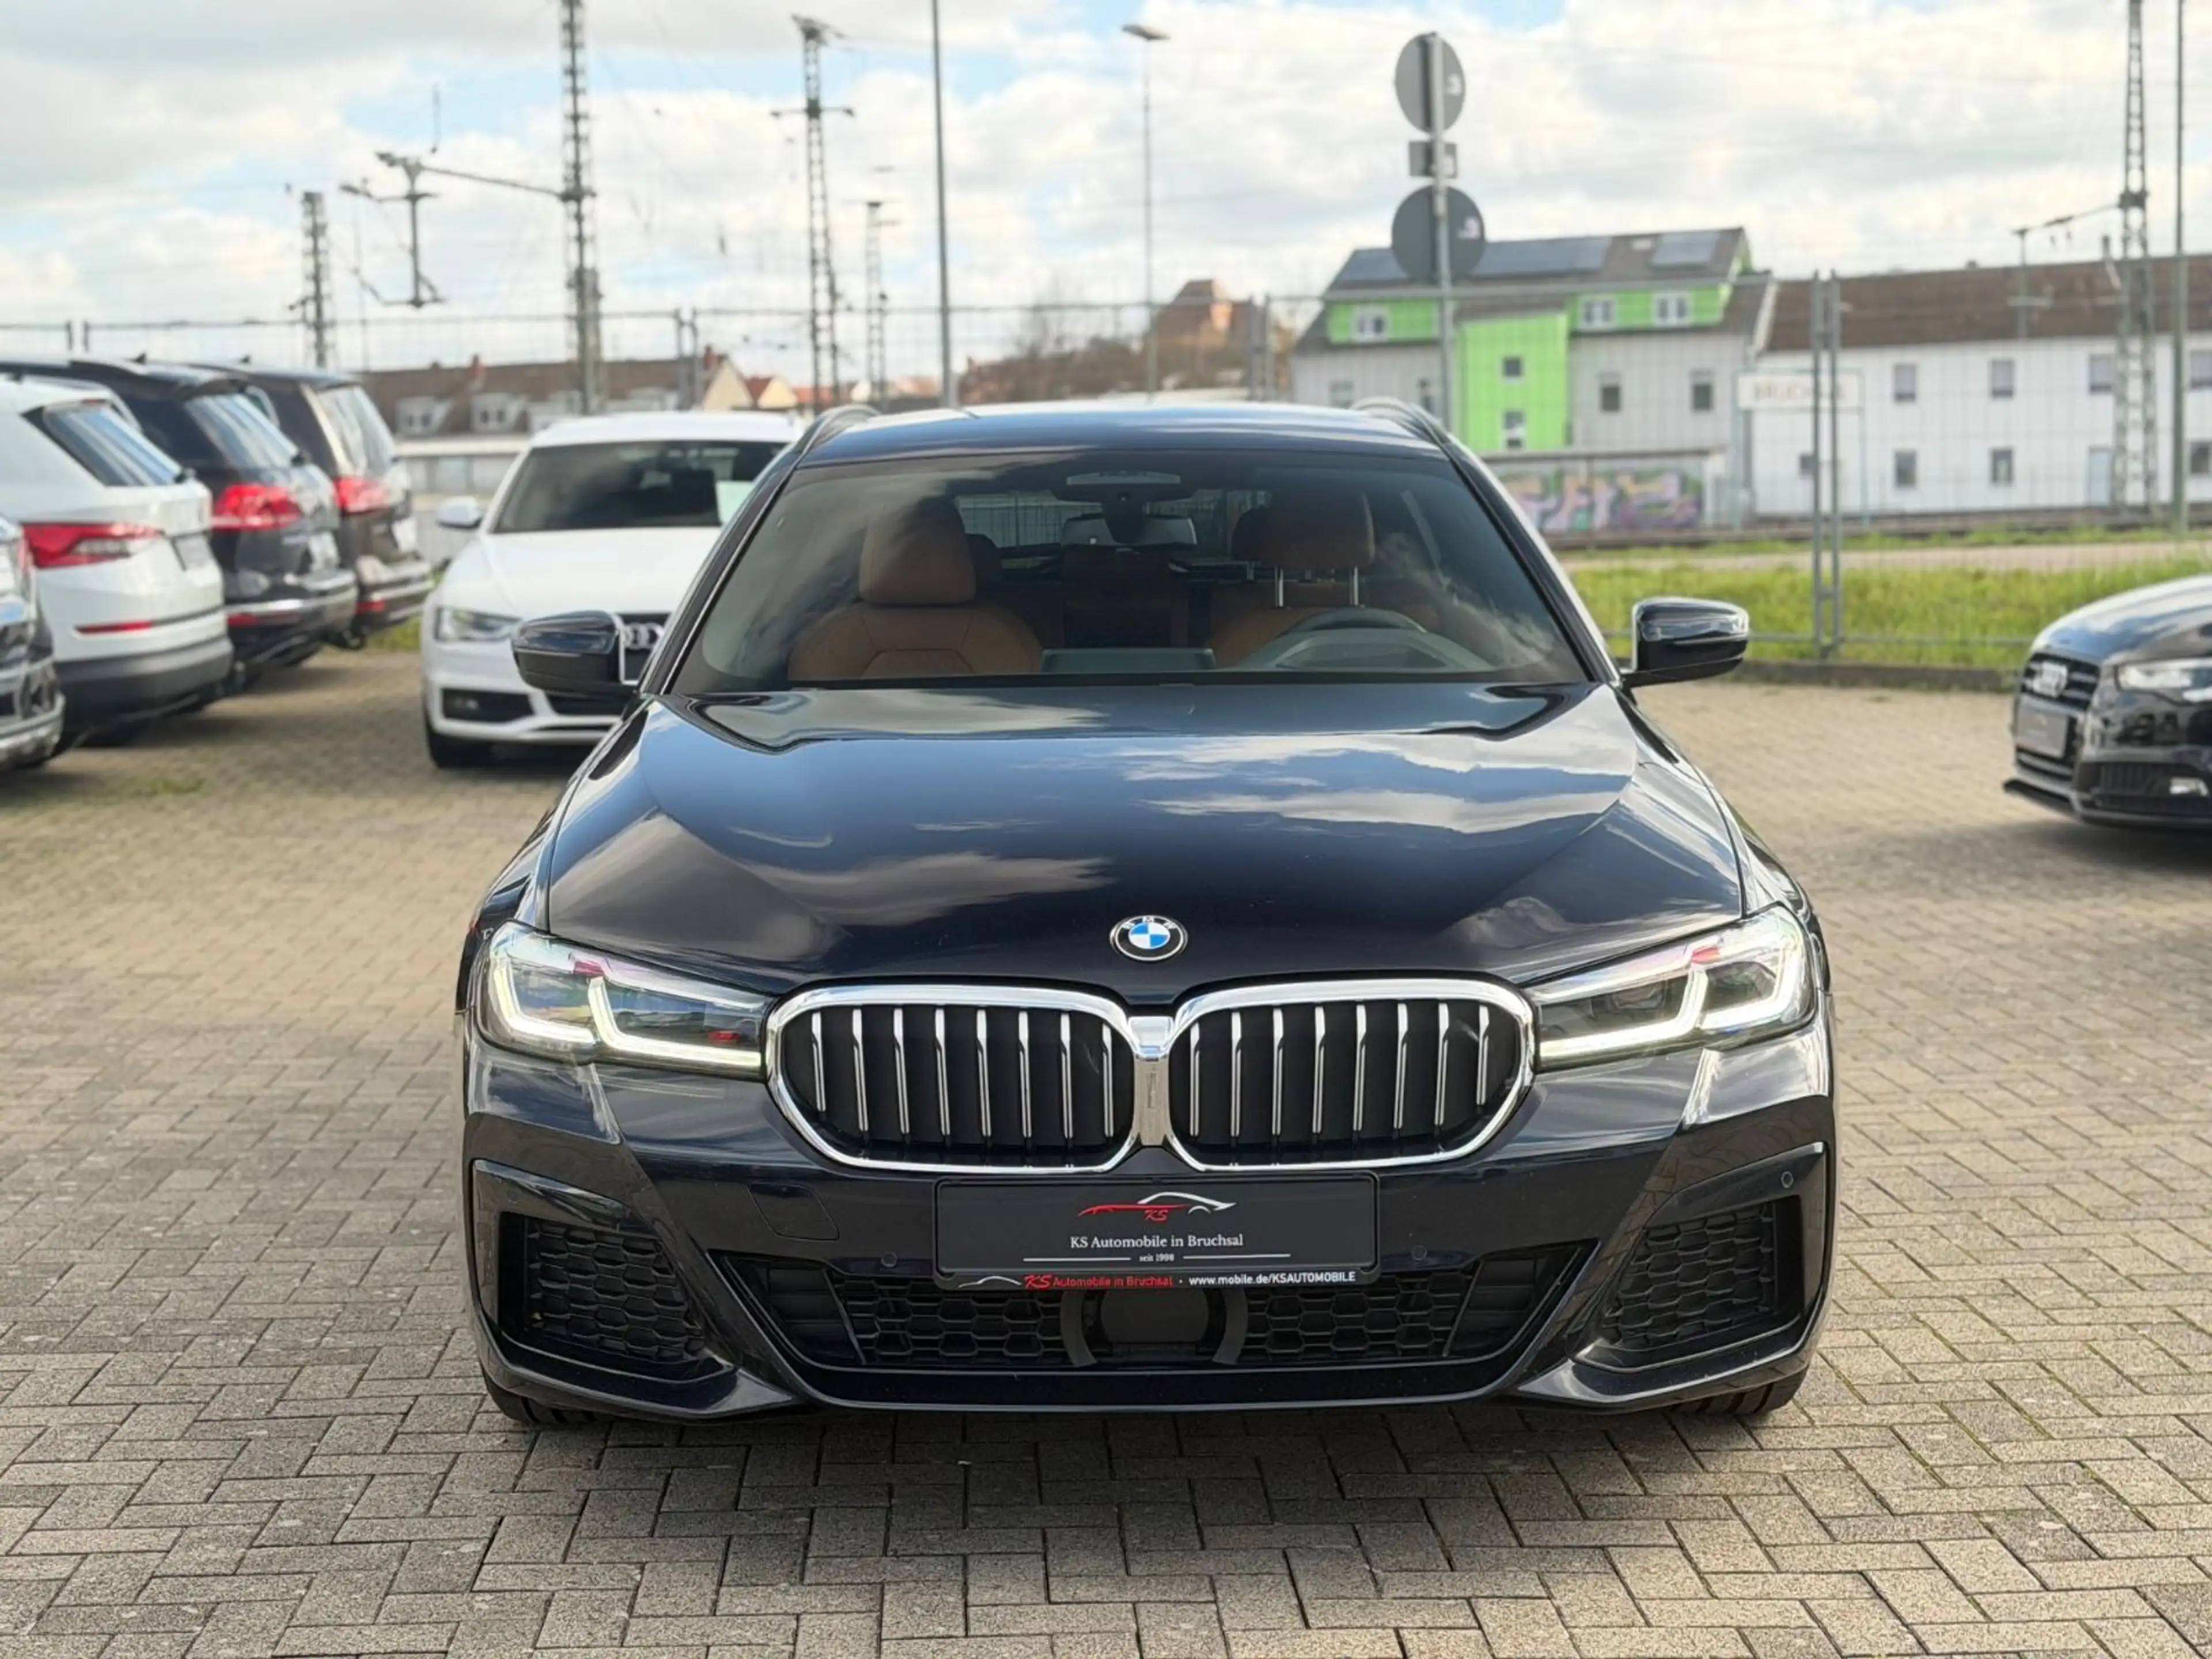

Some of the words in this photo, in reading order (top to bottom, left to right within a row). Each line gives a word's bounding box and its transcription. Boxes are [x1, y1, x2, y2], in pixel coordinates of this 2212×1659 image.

[1145, 1209, 1168, 1222] KS
[1070, 1237, 1088, 1248] KS
[1091, 1236, 1168, 1248] Automobile
[1171, 1235, 1184, 1247] in
[1187, 1233, 1244, 1247] Bruchsal
[1139, 1253, 1153, 1262] seit
[1024, 1274, 1051, 1289] KS
[1054, 1277, 1111, 1287] Automobile
[1114, 1276, 1124, 1286] in
[1126, 1274, 1173, 1286] Bruchsal
[1188, 1271, 1356, 1285] www.mobile.de/KSAUTOMOBILE
